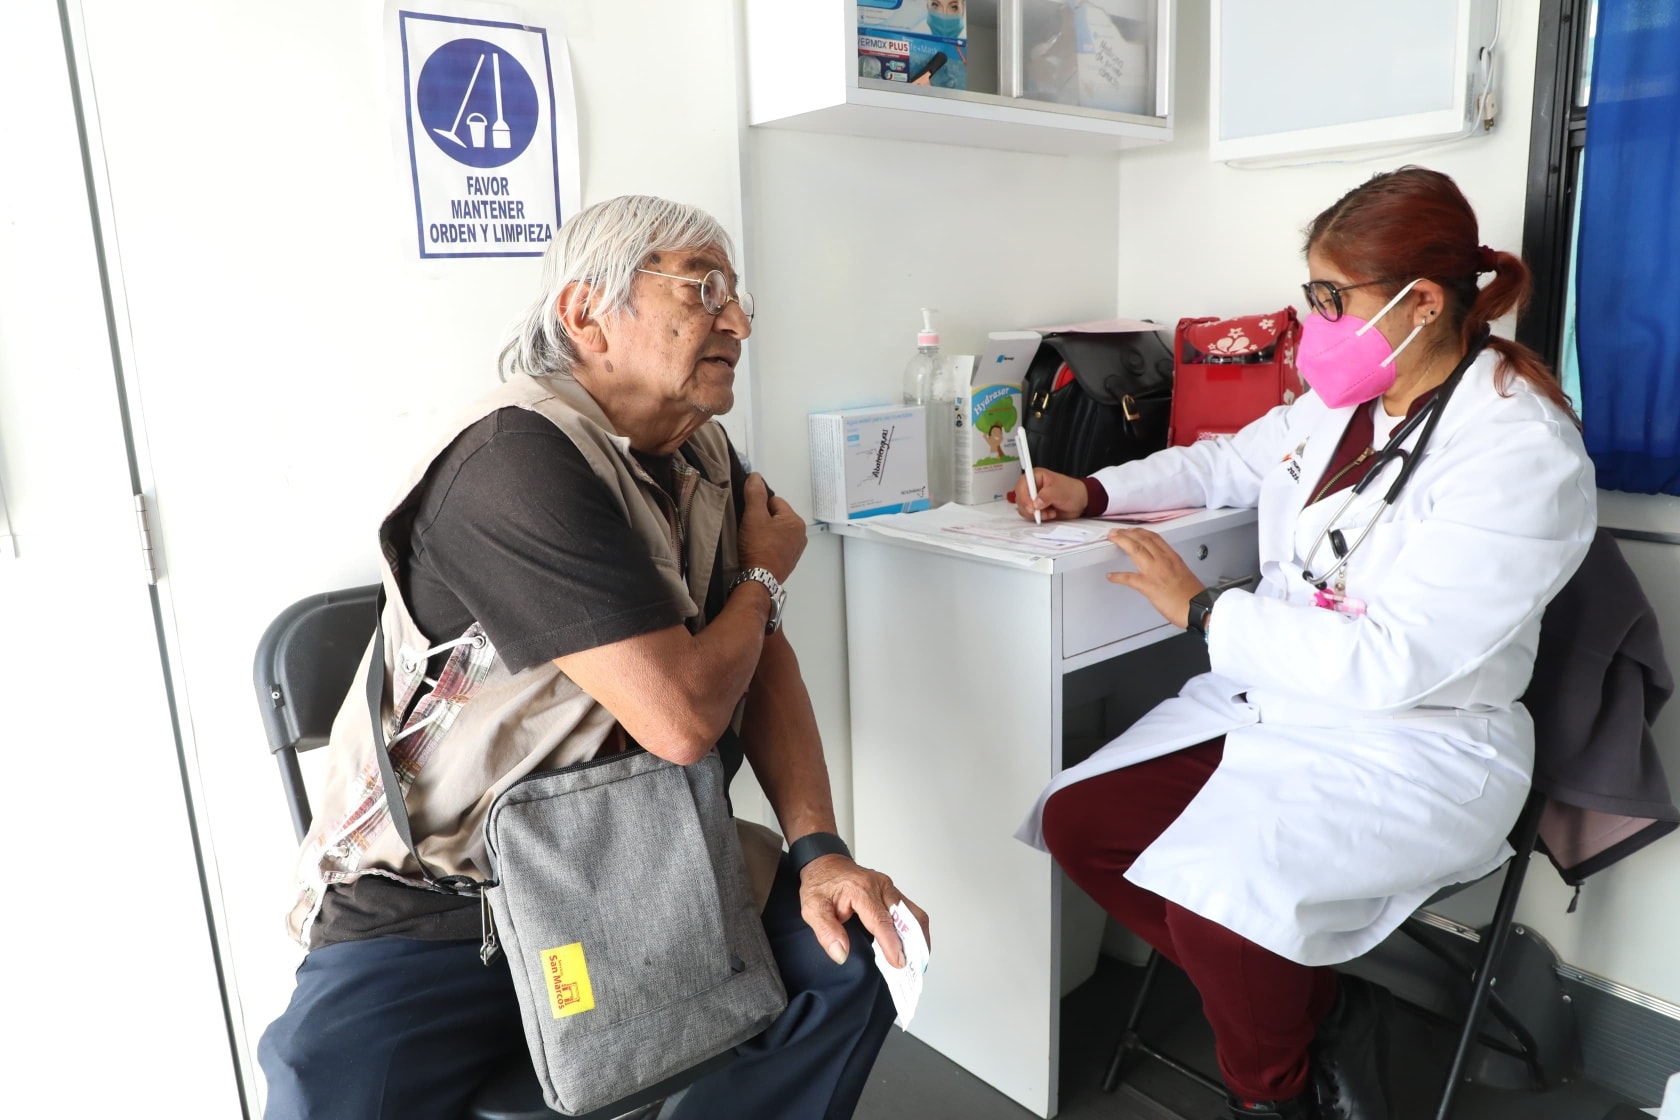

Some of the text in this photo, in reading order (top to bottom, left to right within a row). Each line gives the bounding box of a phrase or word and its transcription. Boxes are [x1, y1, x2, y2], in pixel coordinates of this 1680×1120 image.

[888, 41, 909, 52] PLUS
[466, 175, 510, 196] FAVOR
[451, 199, 526, 220] MANTENER
[429, 223, 553, 243] ORDEN Y LIMPIEZA
[892, 909, 910, 934] DIF
[549, 954, 558, 974] San
[553, 974, 565, 1010] Marcos
